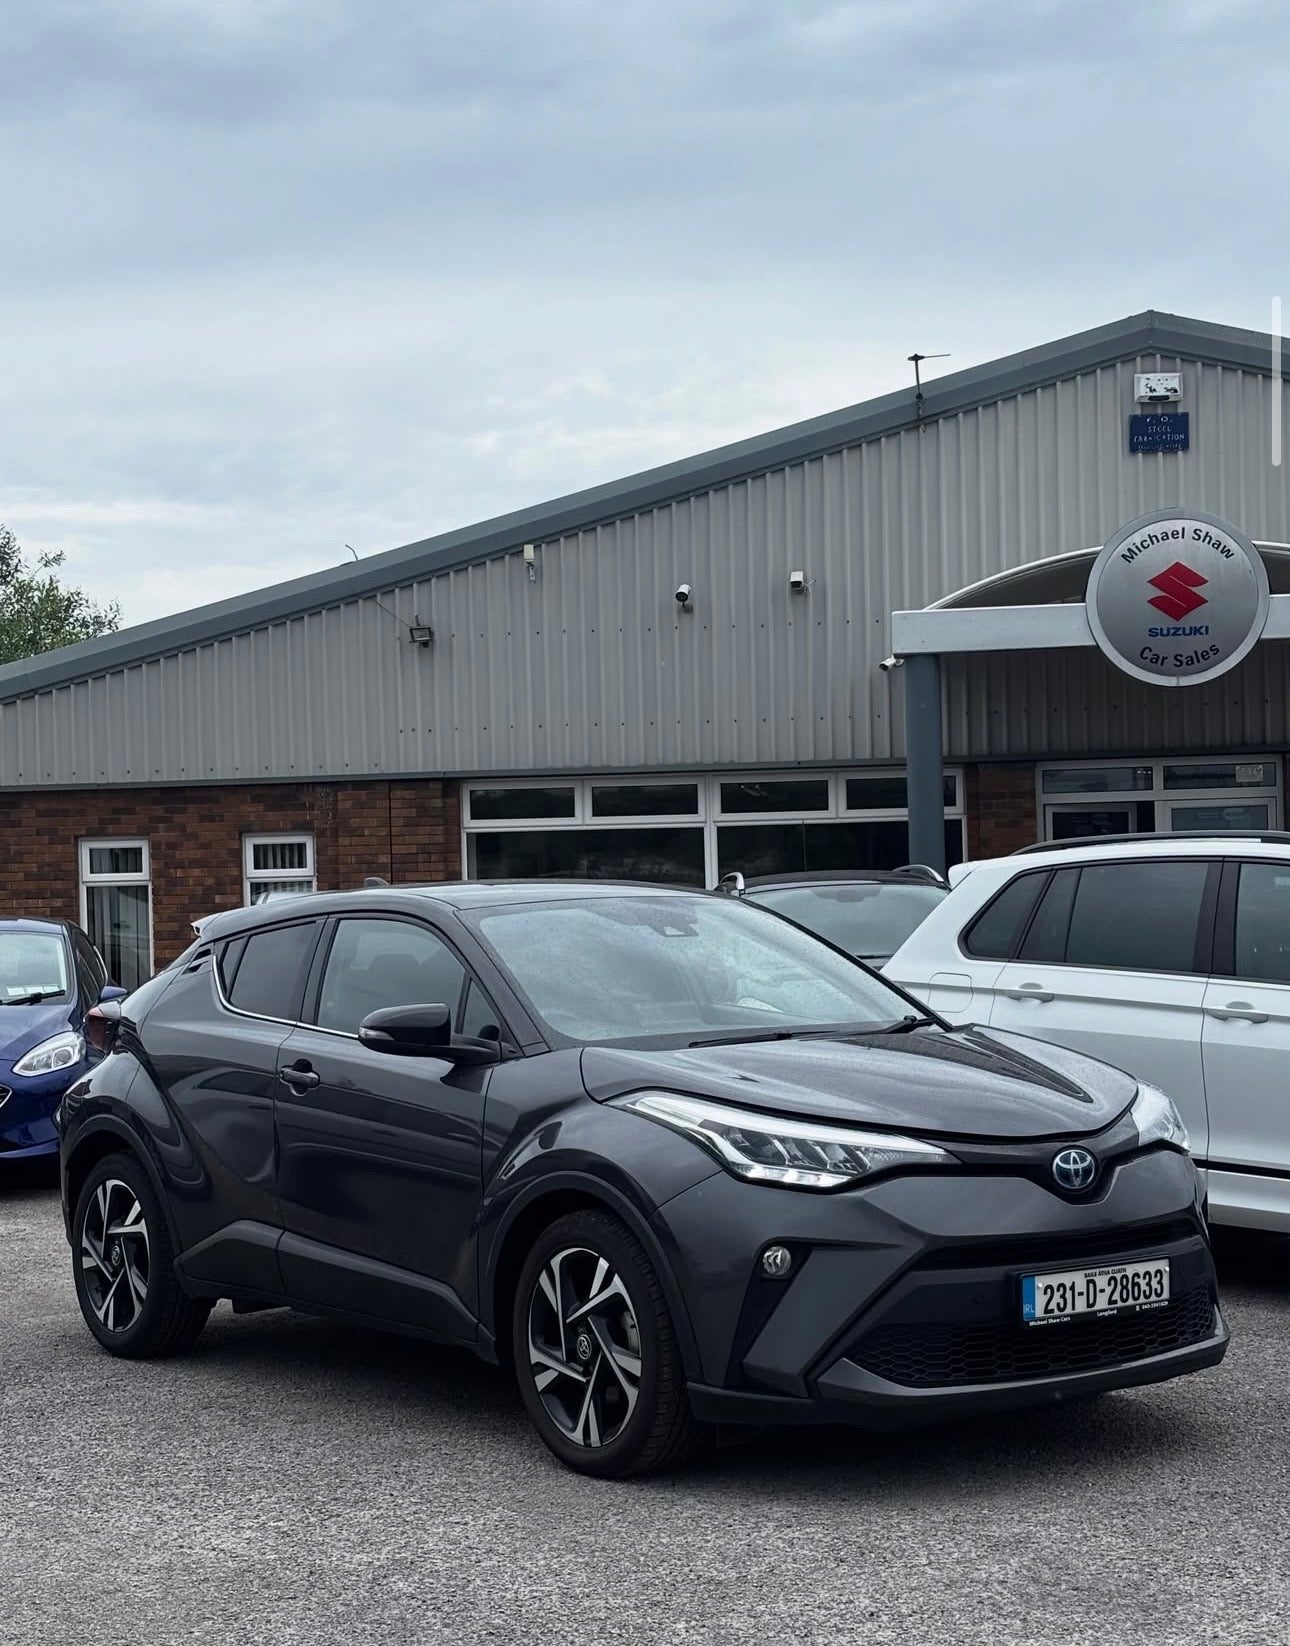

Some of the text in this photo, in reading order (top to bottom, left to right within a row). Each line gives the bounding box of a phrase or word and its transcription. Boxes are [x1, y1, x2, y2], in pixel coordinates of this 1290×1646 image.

[1121, 527, 1235, 563] Michael Shaw
[1147, 625, 1209, 637] SUZUKI
[1139, 644, 1220, 668] Car Sales
[1043, 1269, 1164, 1315] 231-D-28633
[1029, 1318, 1048, 1326] Michael
[1096, 1309, 1117, 1317] Longford
